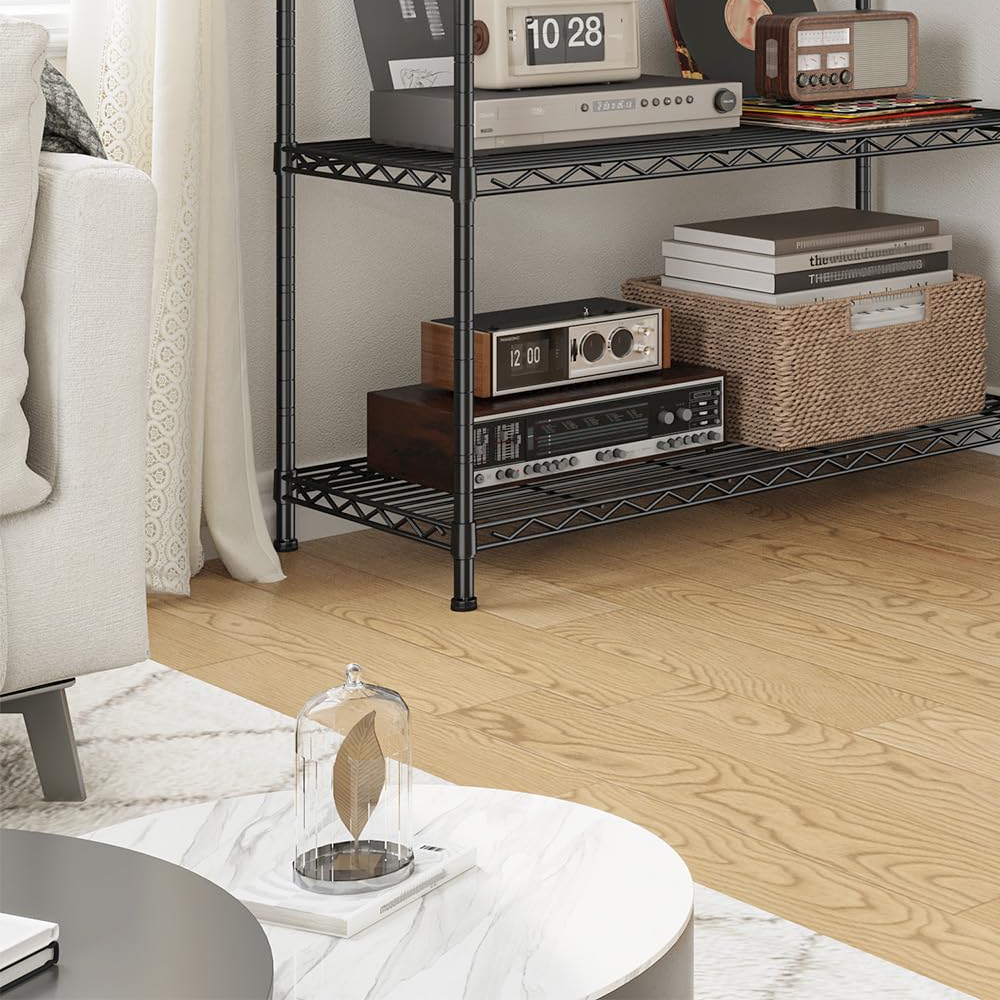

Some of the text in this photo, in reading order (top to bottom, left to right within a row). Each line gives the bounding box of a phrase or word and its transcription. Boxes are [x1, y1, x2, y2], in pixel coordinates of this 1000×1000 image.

[527, 16, 602, 49] 10 28
[510, 346, 541, 367] 12 00
